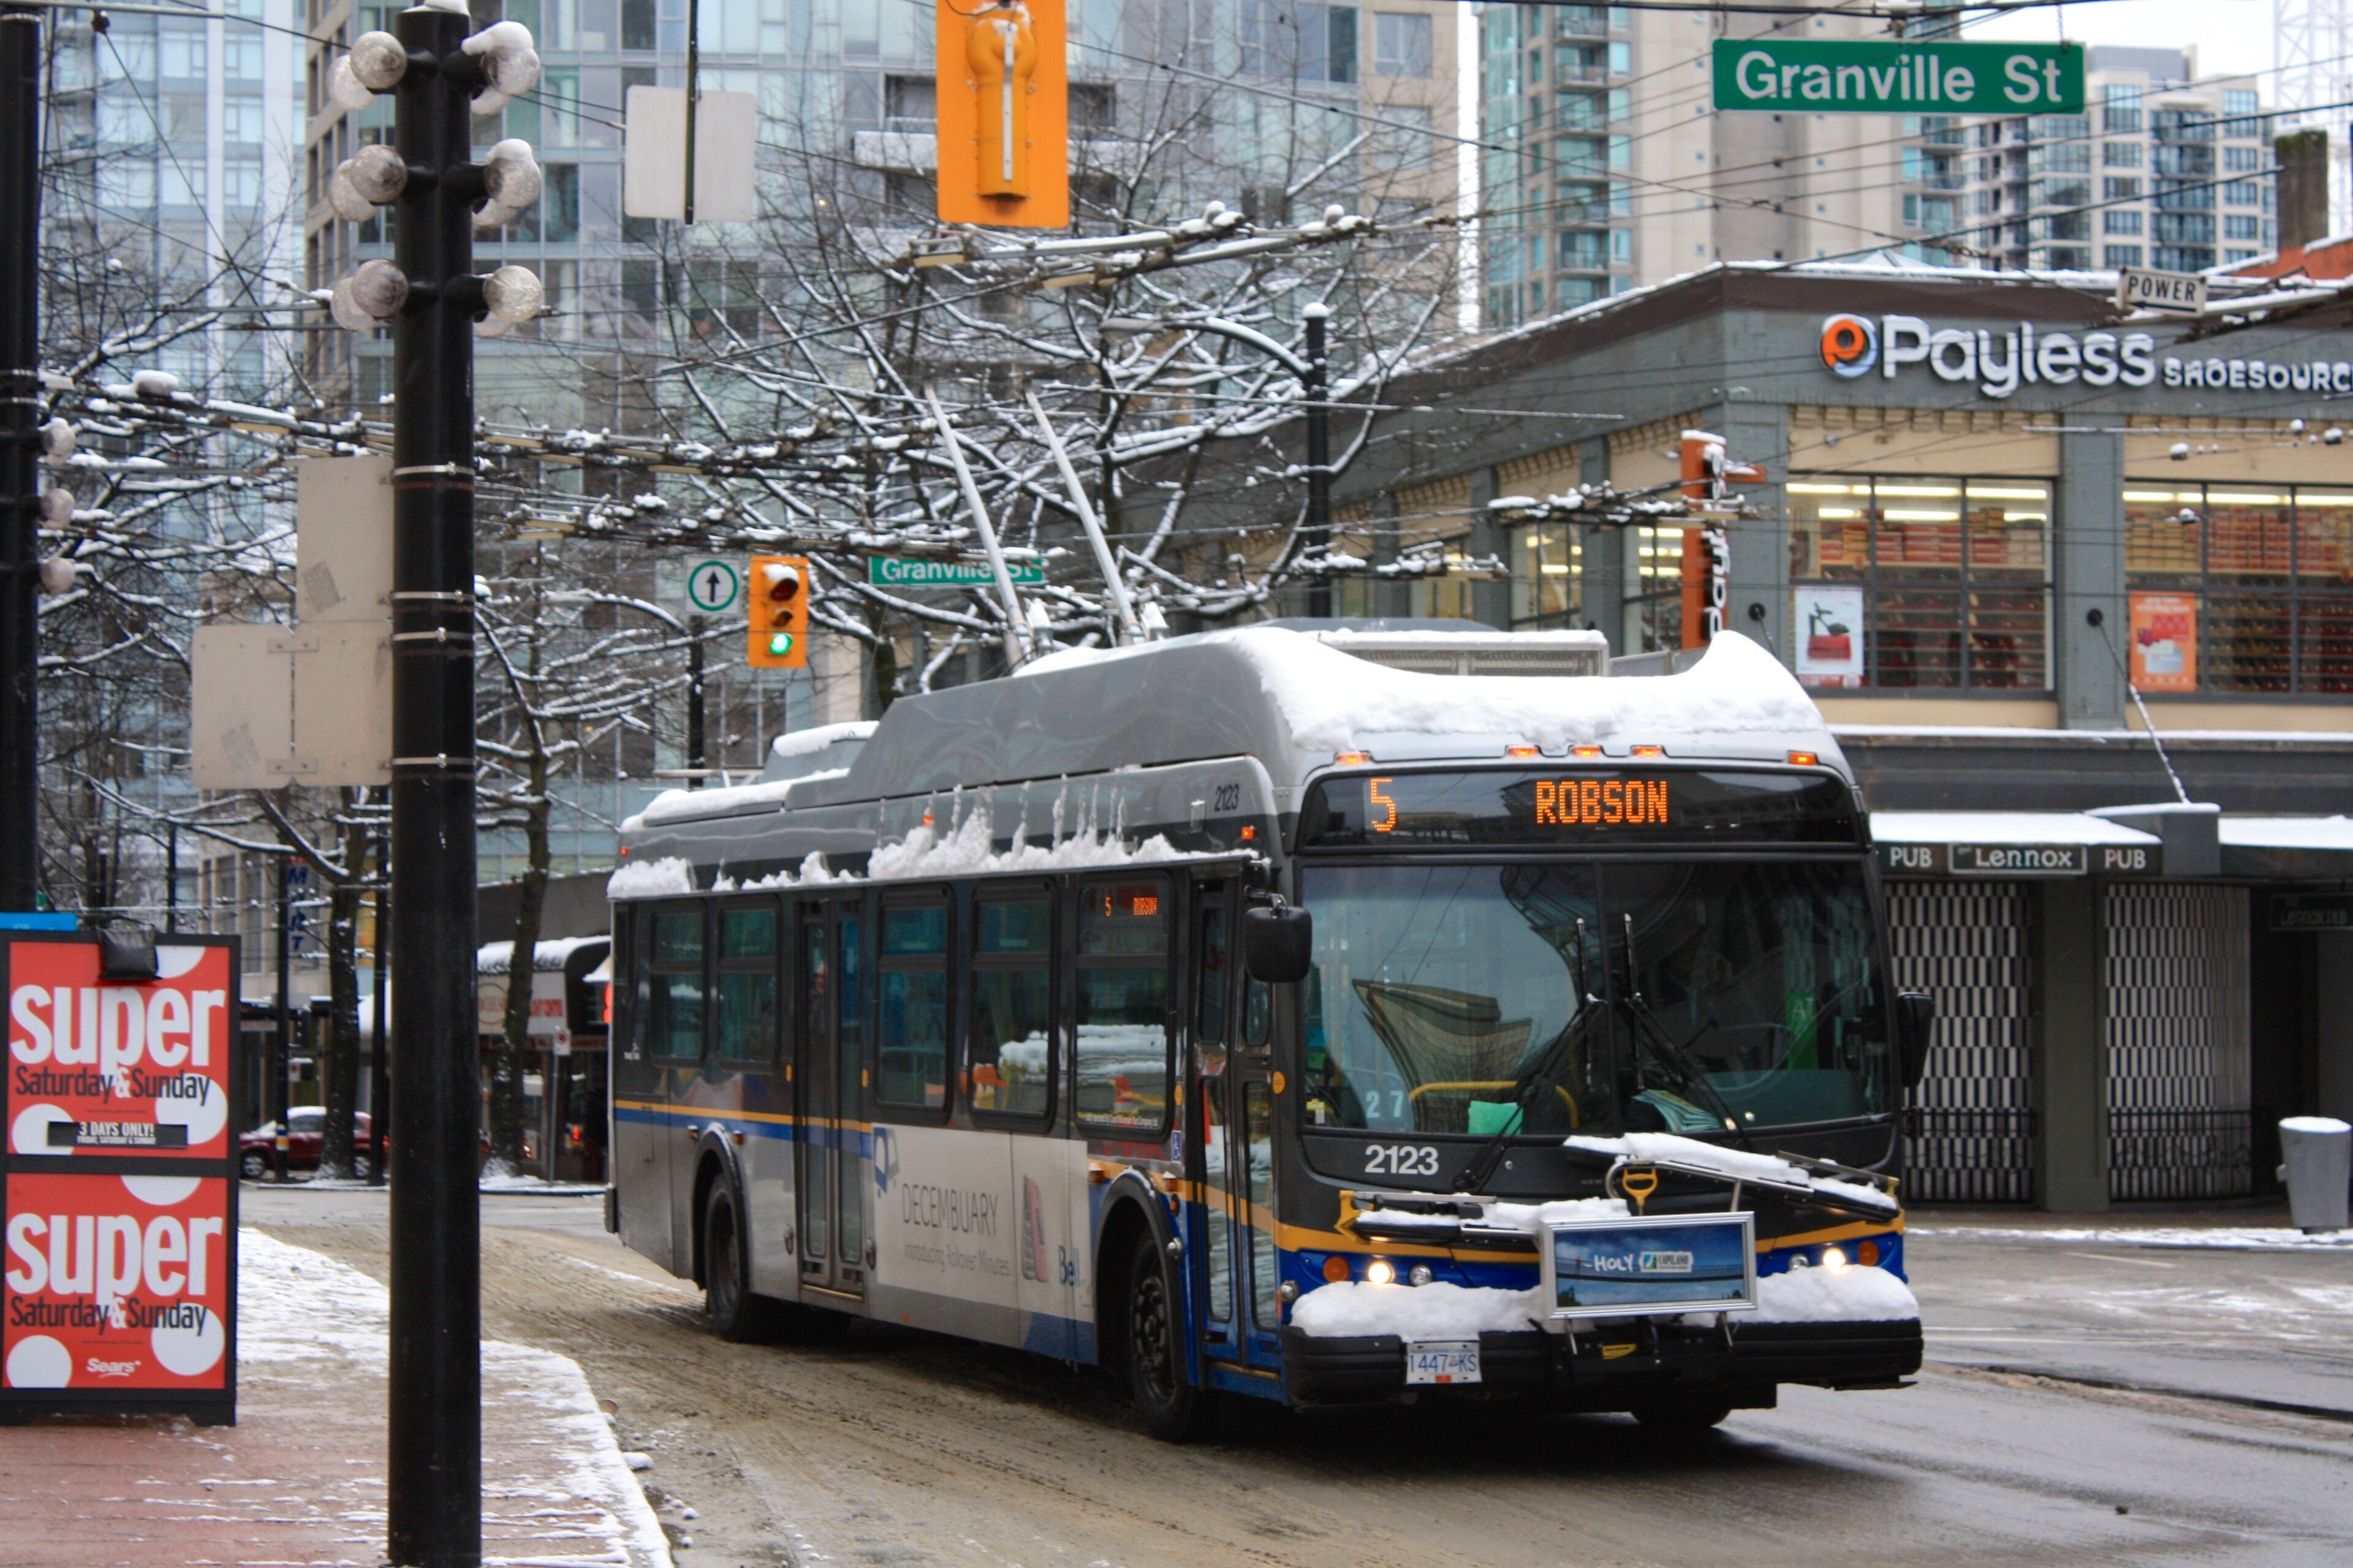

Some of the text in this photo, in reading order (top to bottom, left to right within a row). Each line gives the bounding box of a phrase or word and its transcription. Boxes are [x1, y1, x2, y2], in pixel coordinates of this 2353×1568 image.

[1736, 50, 2062, 104] Granville St
[2128, 276, 2196, 301] POWER
[1881, 314, 2353, 398] Payless SHOESOURC
[881, 558, 993, 581] Granville
[1214, 783, 1240, 812] 2123
[1370, 777, 1669, 834] 5 ROBSON
[1890, 846, 1933, 867] PUB
[1975, 847, 2072, 868] Lennox
[2104, 849, 2146, 869] PUB
[10, 984, 225, 1086] super
[15, 1065, 113, 1104] Saturday
[131, 1067, 211, 1107] Sunday
[79, 1121, 154, 1137] 3 DAYS ONLY!
[1364, 1144, 1439, 1176] 2123
[903, 1183, 998, 1237] DECEMBUARY
[5, 1212, 223, 1317] super
[1058, 1244, 1080, 1287] Bell
[1594, 1253, 1634, 1273] HOLY
[10, 1295, 110, 1336] Saturday
[127, 1297, 208, 1337] Sunday
[86, 1357, 135, 1374] Sears
